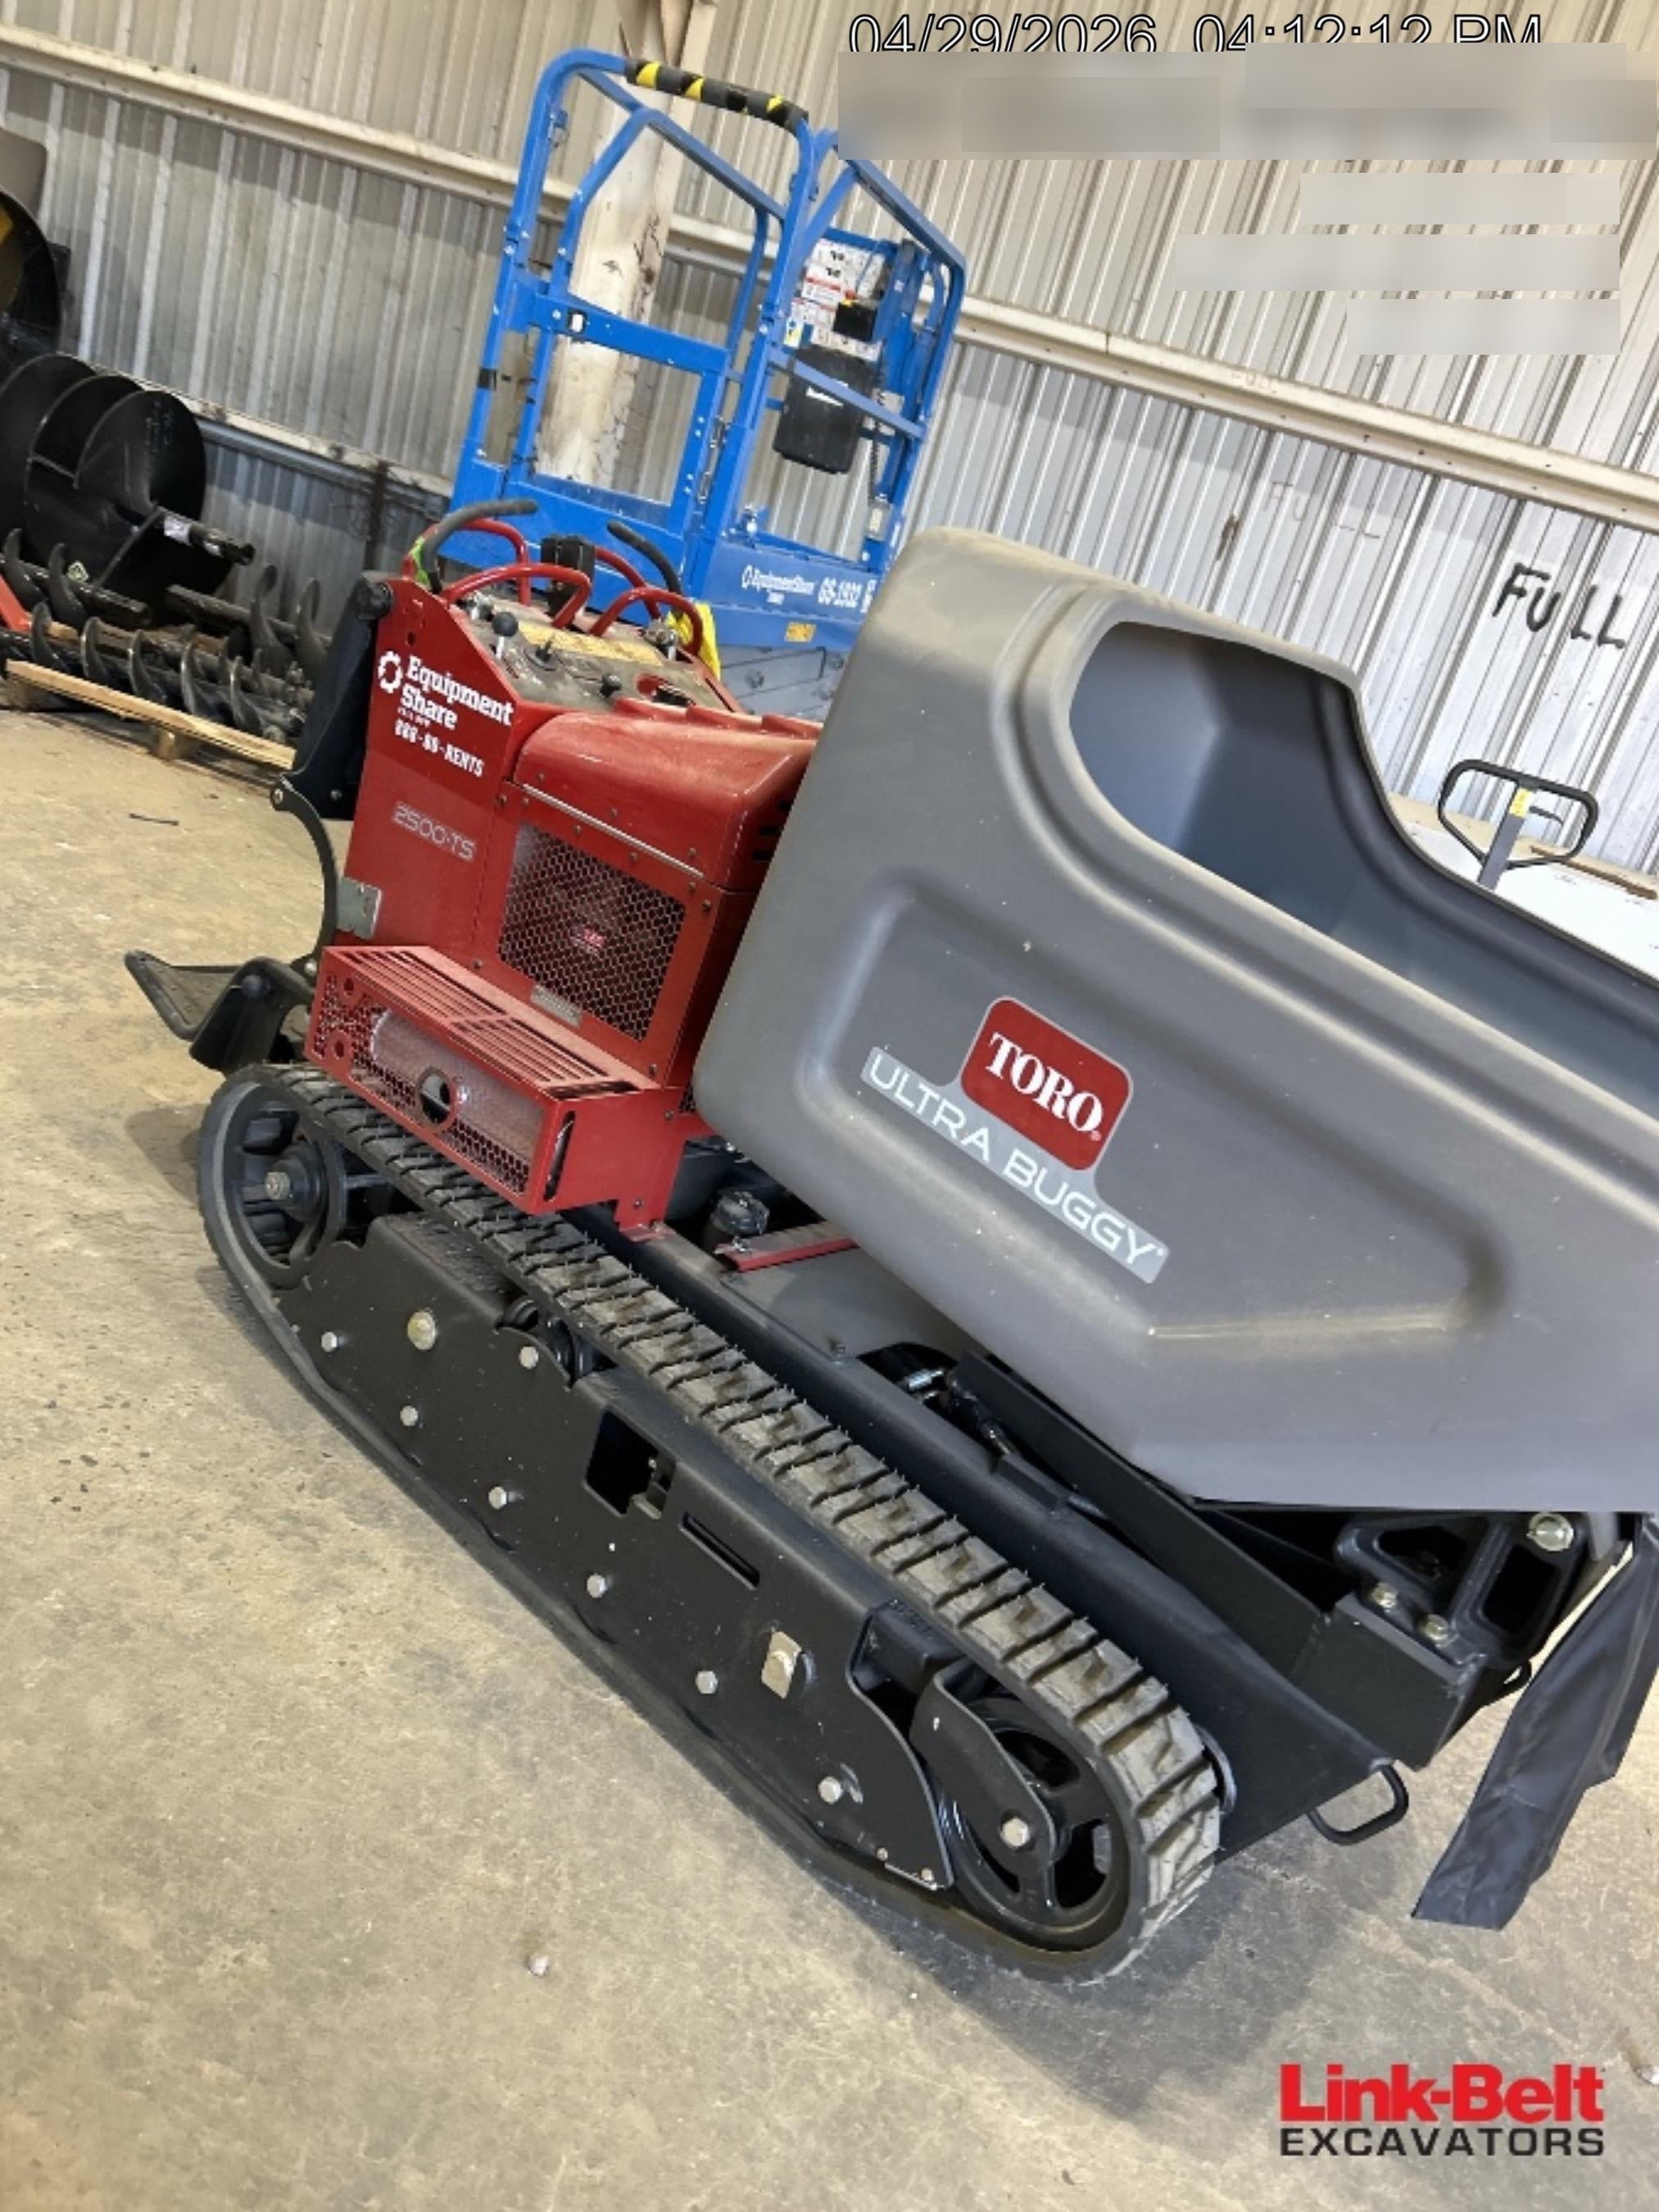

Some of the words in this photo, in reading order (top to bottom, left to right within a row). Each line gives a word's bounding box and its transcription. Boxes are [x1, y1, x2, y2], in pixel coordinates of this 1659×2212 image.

[1491, 562, 1626, 650] FULL
[401, 682, 458, 730] Share
[406, 655, 514, 727] Equipment
[984, 1031, 1104, 1133] TORO
[868, 1053, 992, 1163] ULTRA
[1002, 1147, 1158, 1266] BUGGY
